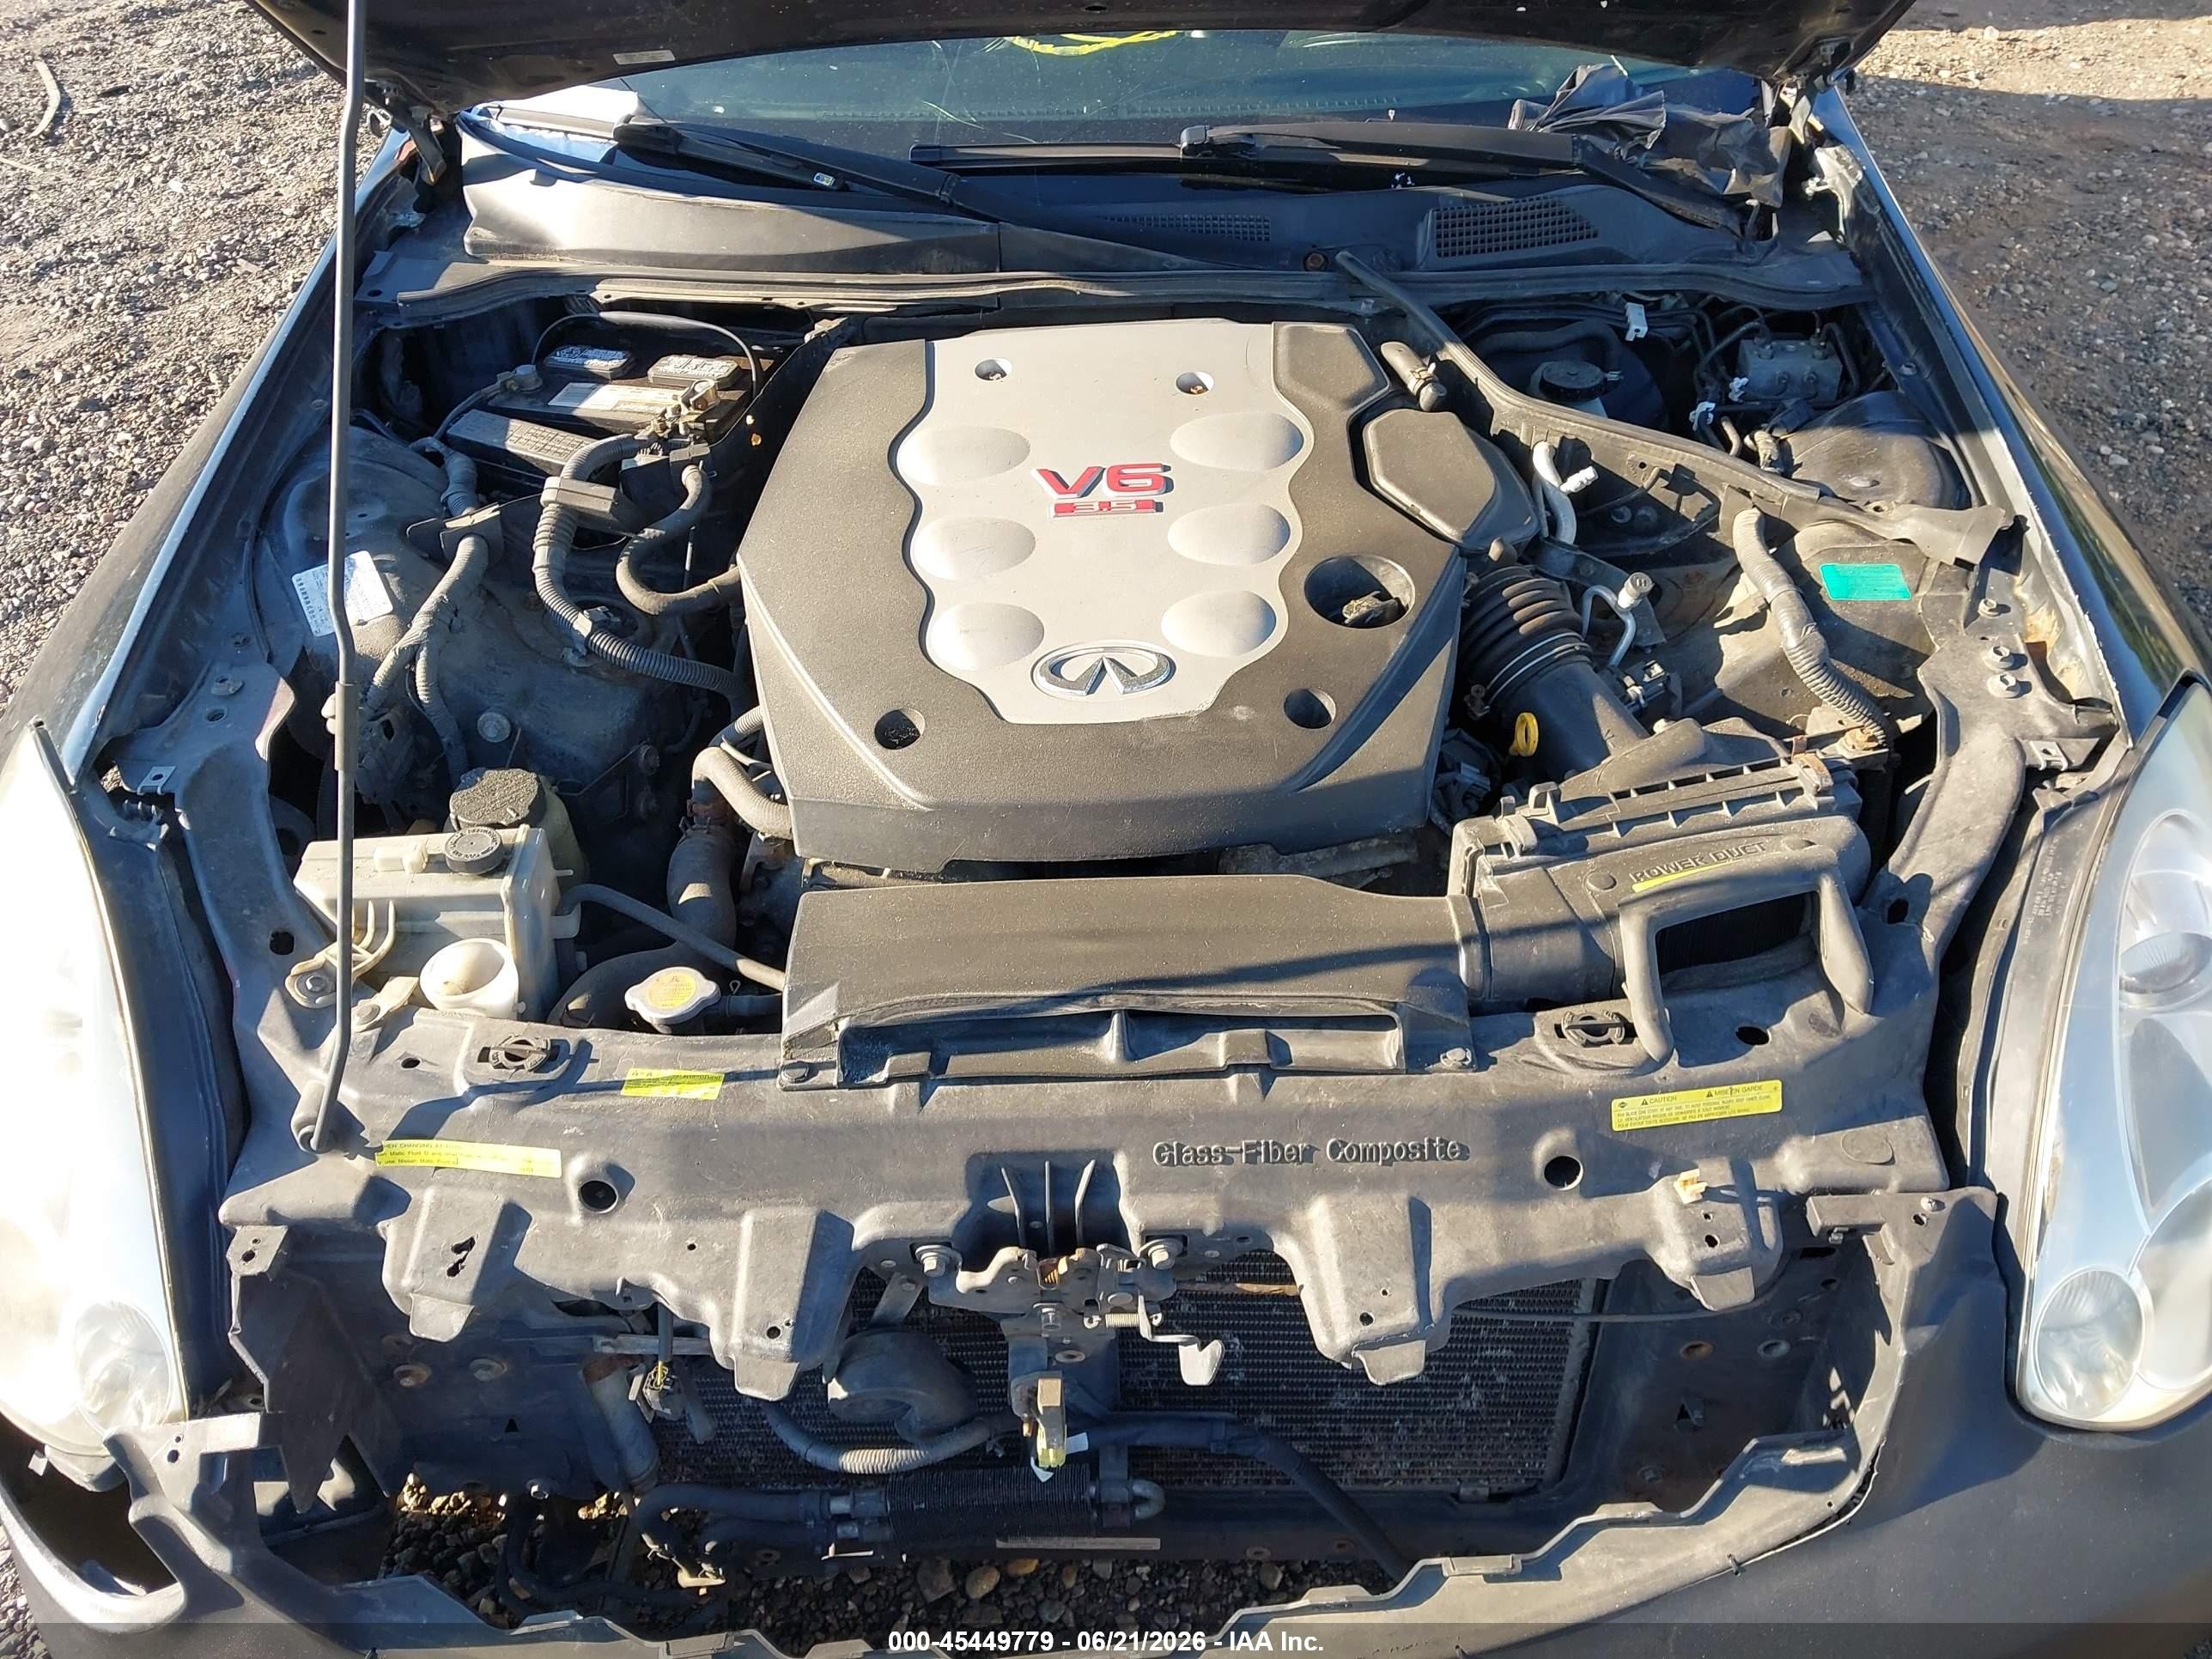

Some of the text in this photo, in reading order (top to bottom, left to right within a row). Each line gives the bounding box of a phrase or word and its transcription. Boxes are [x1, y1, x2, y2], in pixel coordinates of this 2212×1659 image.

[1035, 463, 1169, 498] V6
[1070, 500, 1139, 514] 3.5
[1629, 842, 1766, 883] POWER DUCT
[1741, 1084, 1763, 1093] GARDE
[1649, 1095, 1677, 1104] CAUTION
[1152, 1137, 1462, 1166] Glass-Fiber Composite
